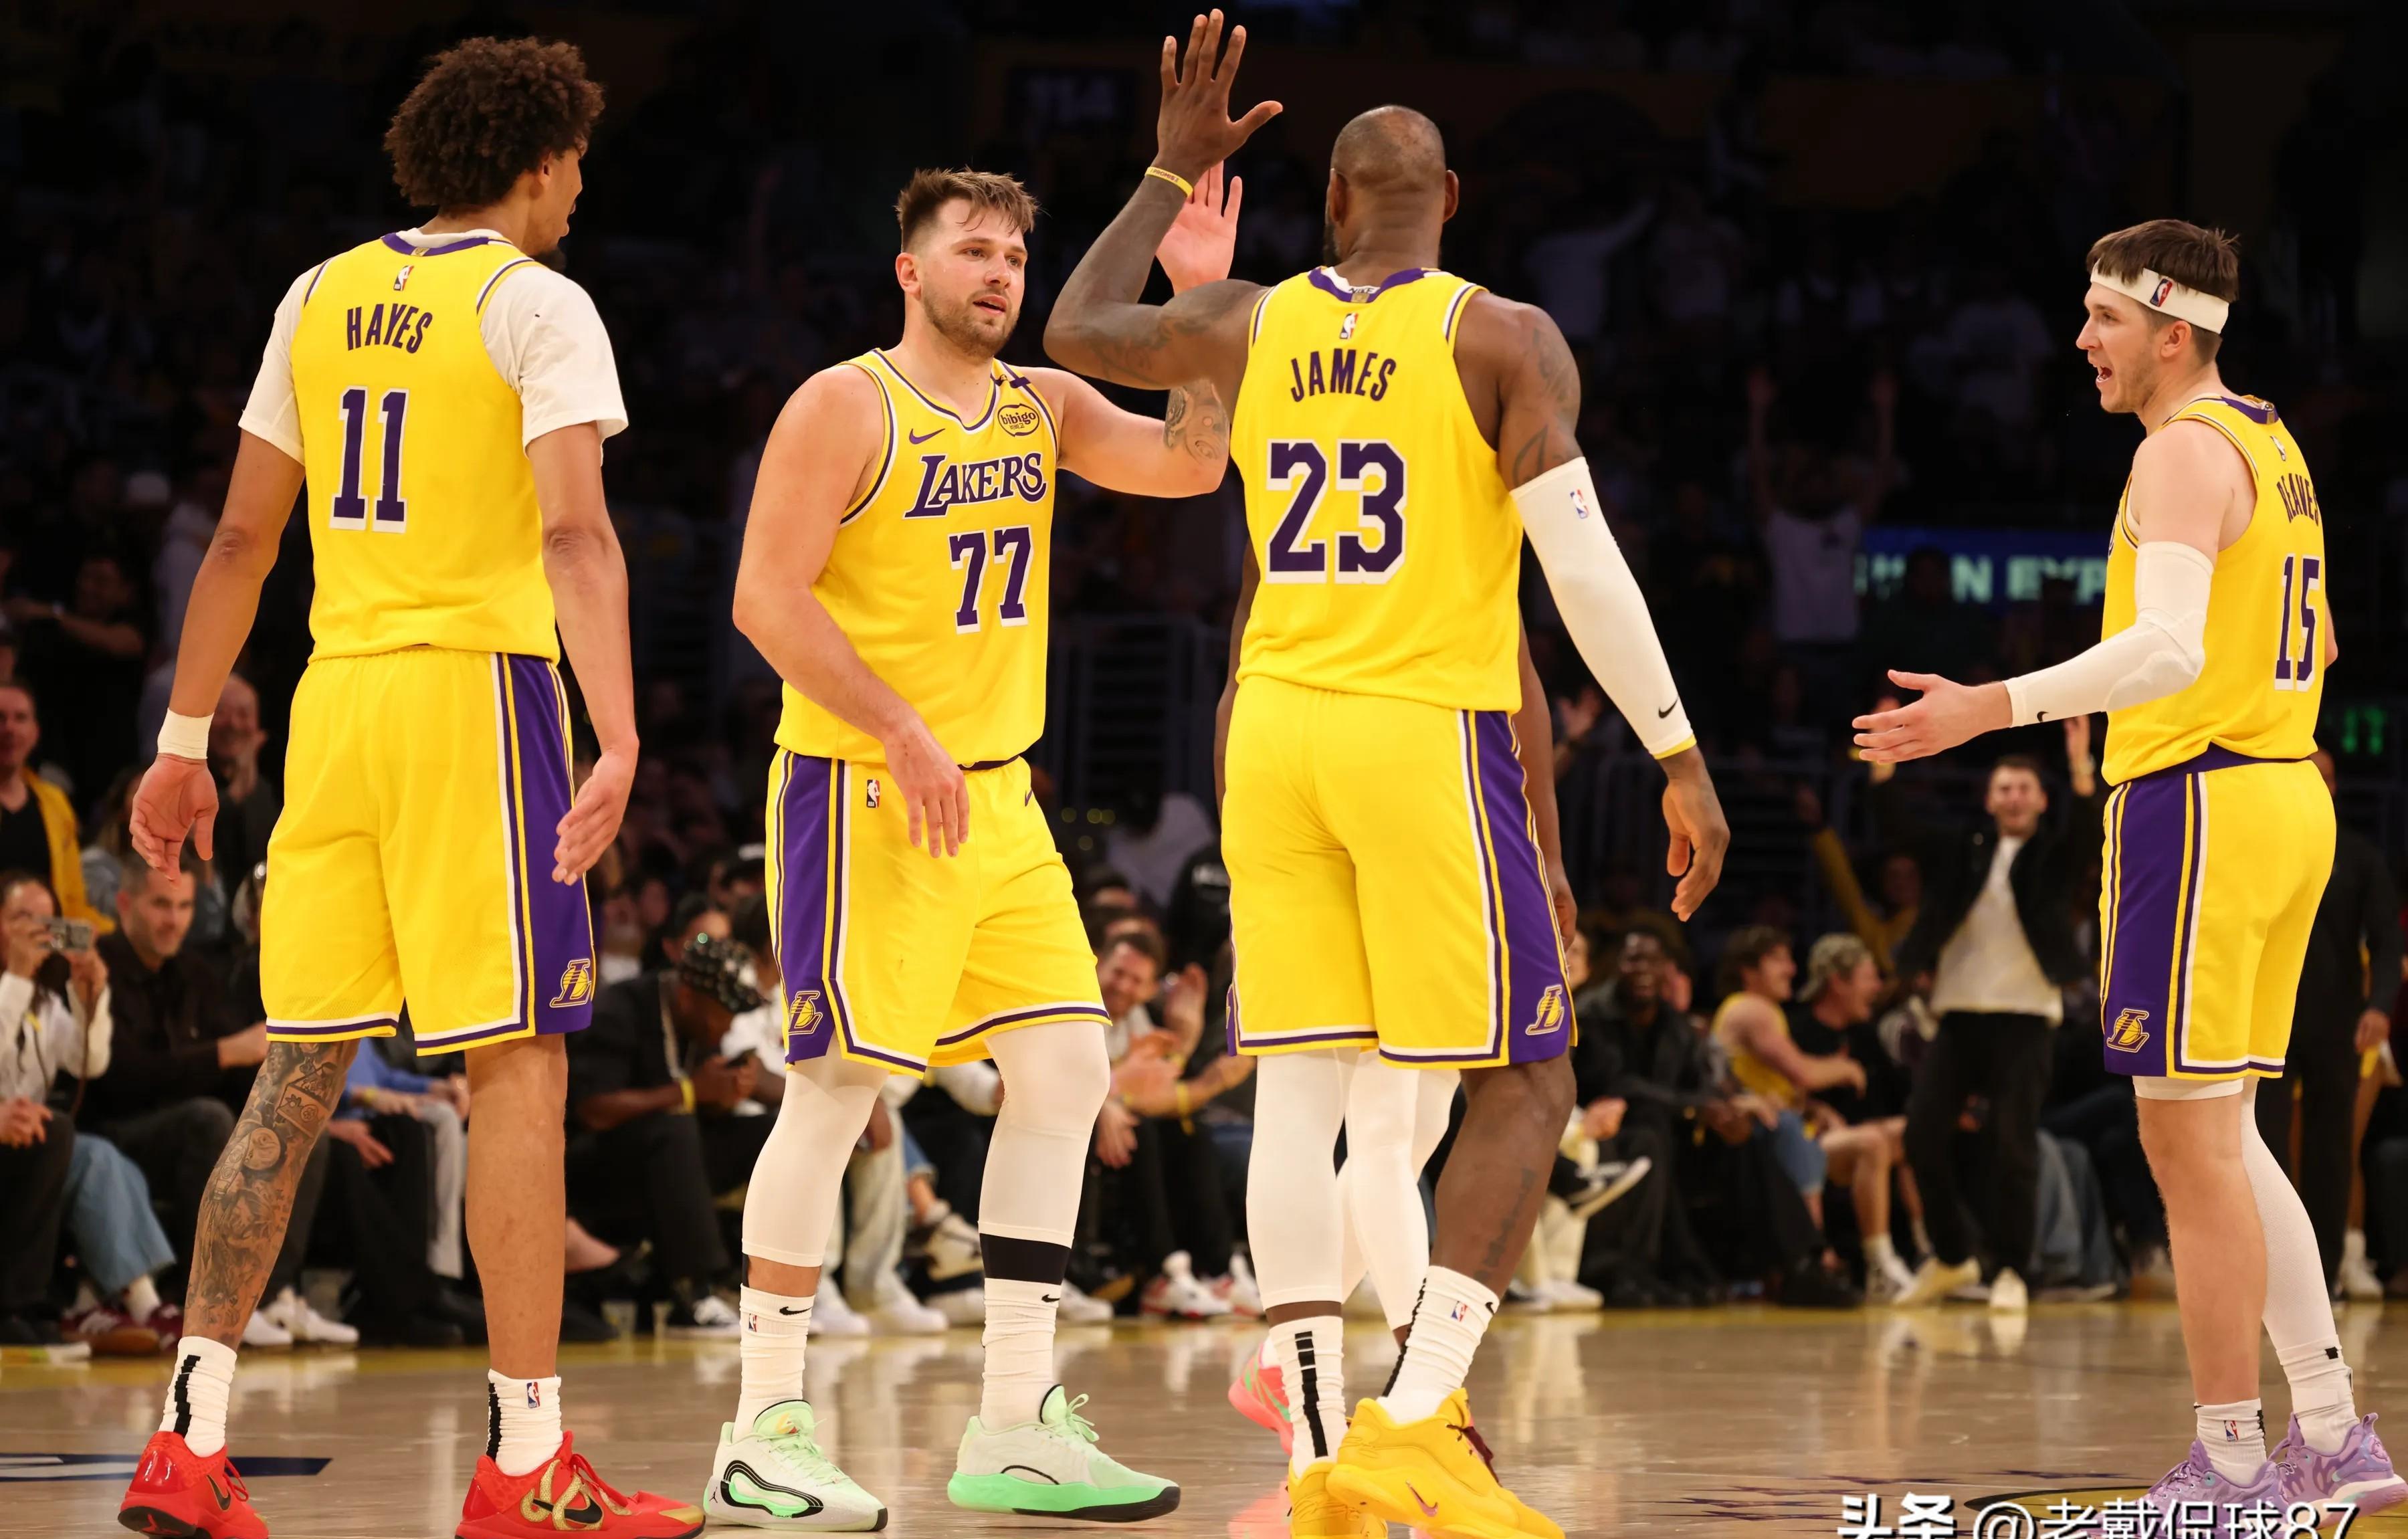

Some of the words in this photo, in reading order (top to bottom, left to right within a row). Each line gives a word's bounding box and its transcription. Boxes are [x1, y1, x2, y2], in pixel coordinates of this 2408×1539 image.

[346, 303, 433, 354] HAYES
[1001, 411, 1036, 425] bibigo
[1290, 348, 1397, 403] JAMES
[329, 385, 410, 533] 11
[903, 452, 1047, 519] LAKERS
[1266, 438, 1407, 584] 23
[948, 524, 1034, 634] 77
[2274, 552, 2321, 692] 15
